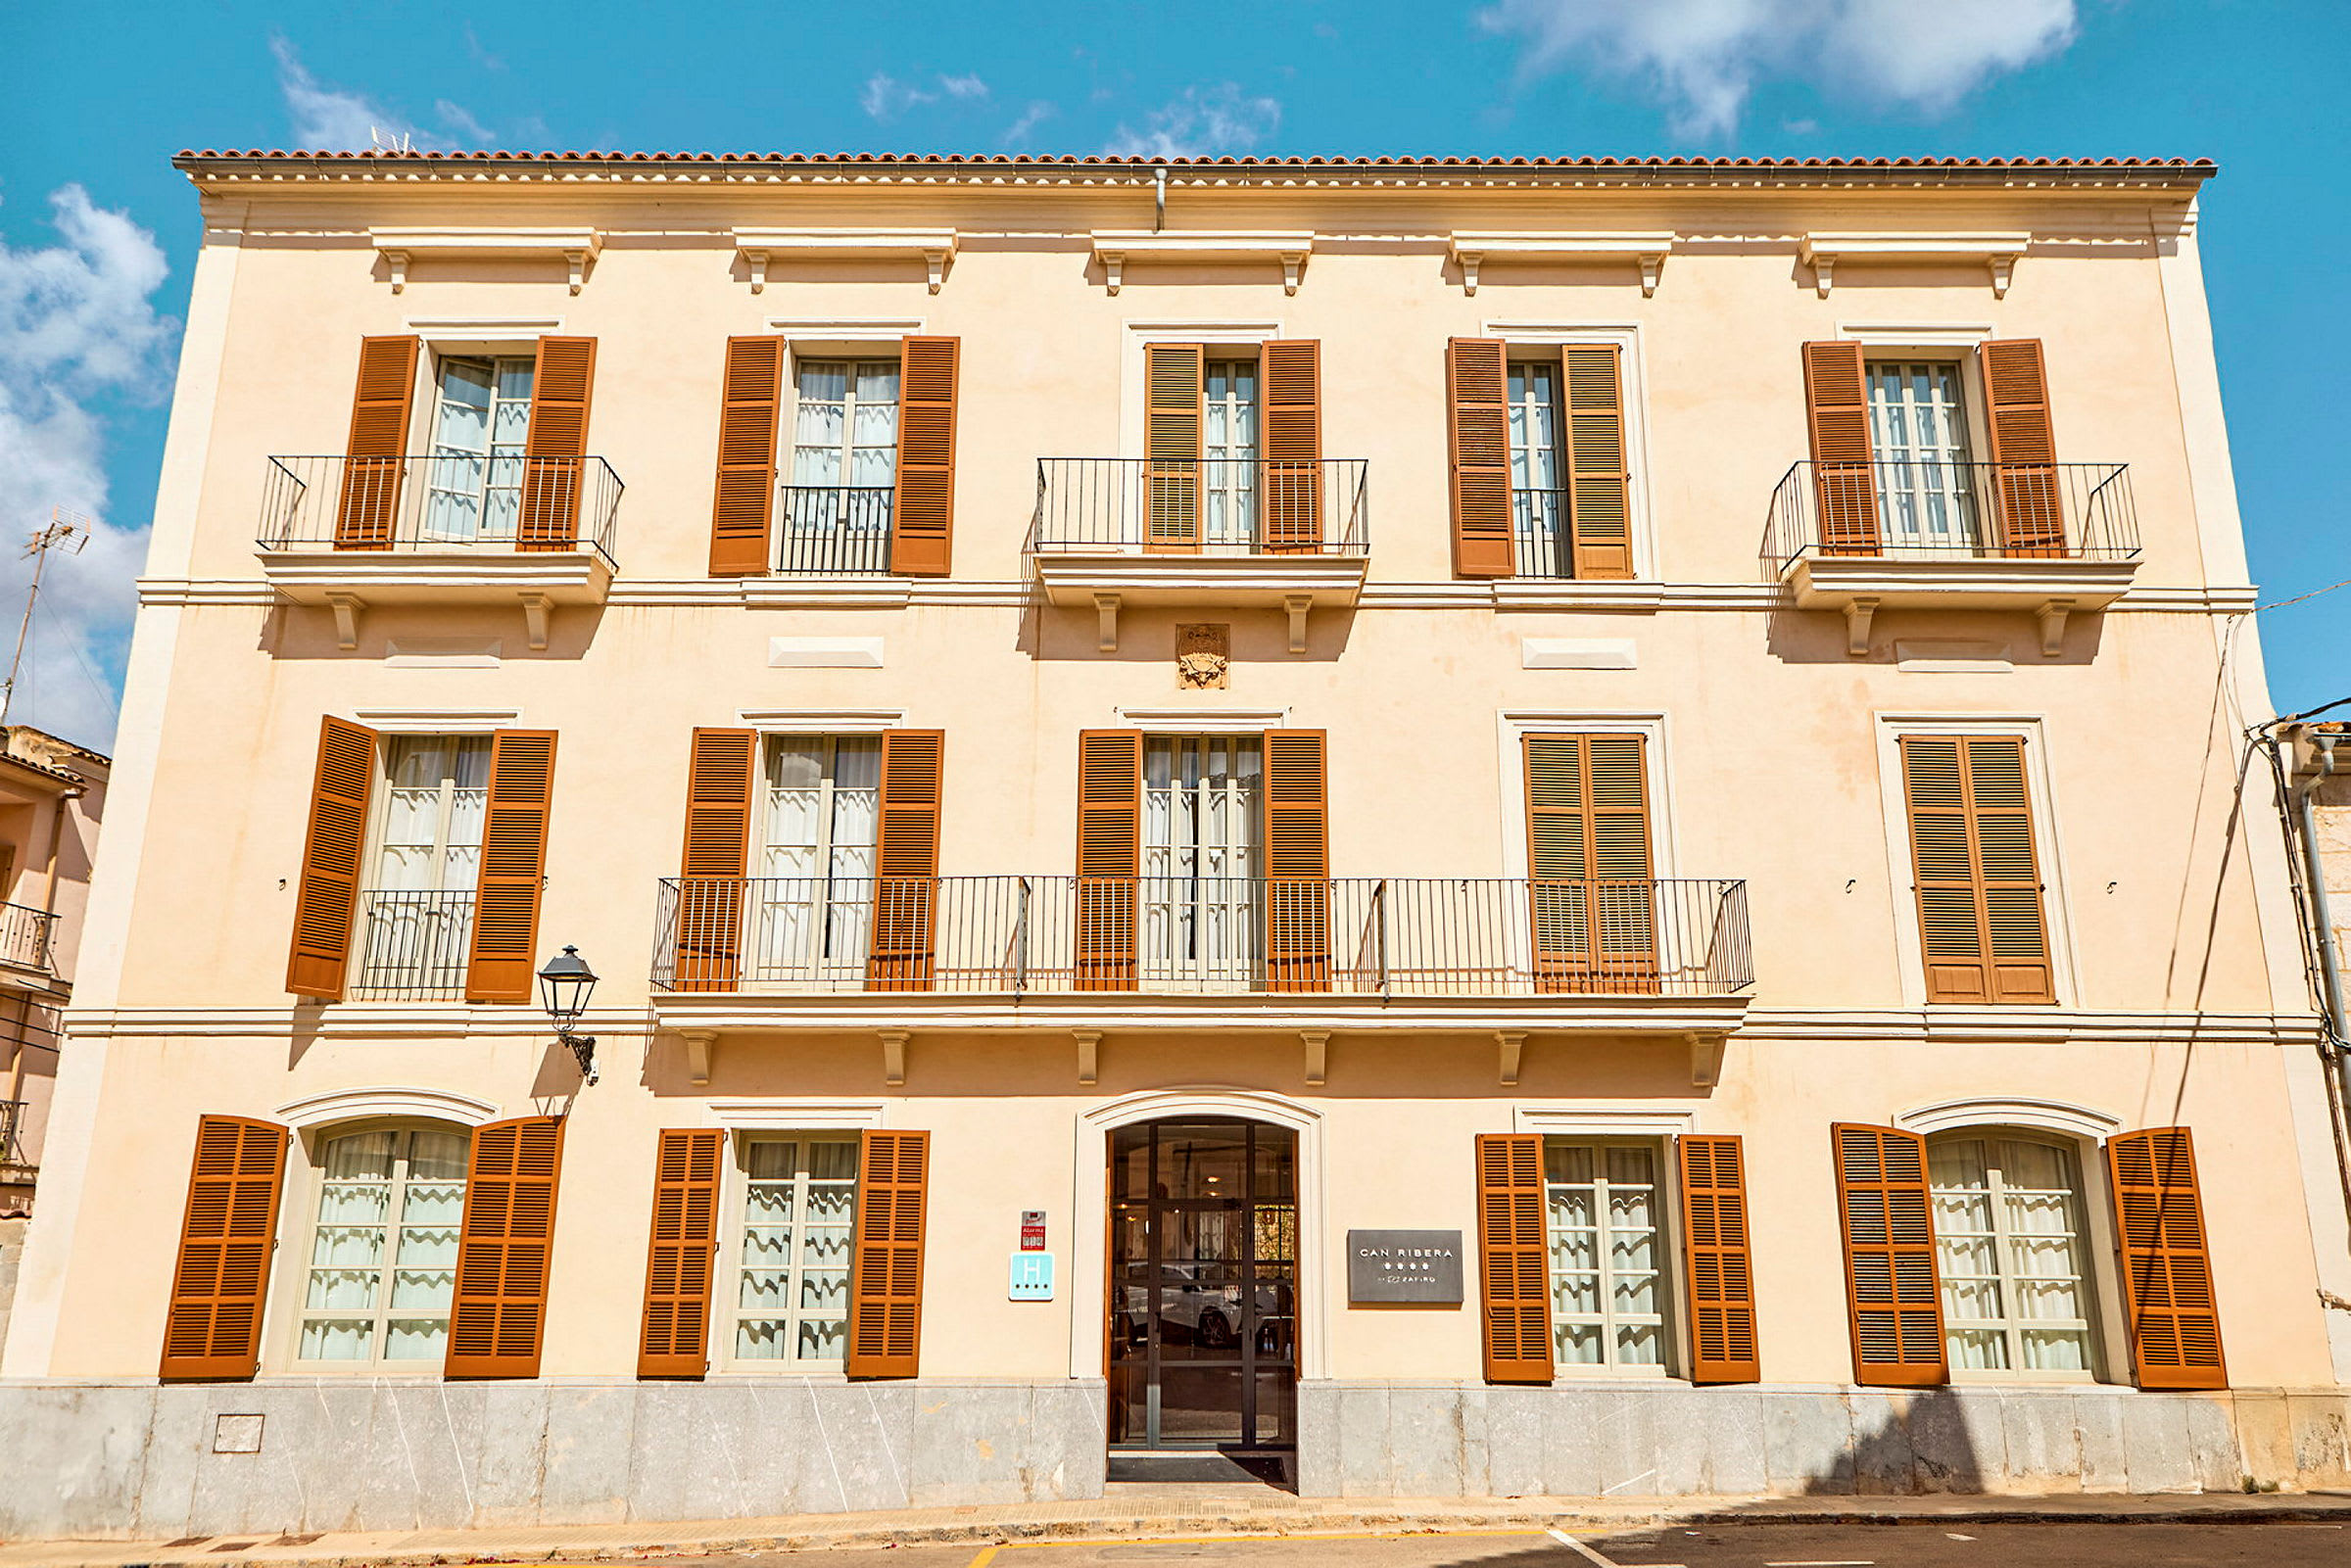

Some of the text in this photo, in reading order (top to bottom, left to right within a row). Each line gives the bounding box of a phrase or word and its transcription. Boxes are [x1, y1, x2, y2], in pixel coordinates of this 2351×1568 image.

[1360, 1249, 1453, 1258] CAN RIBERA
[1024, 1258, 1041, 1282] H
